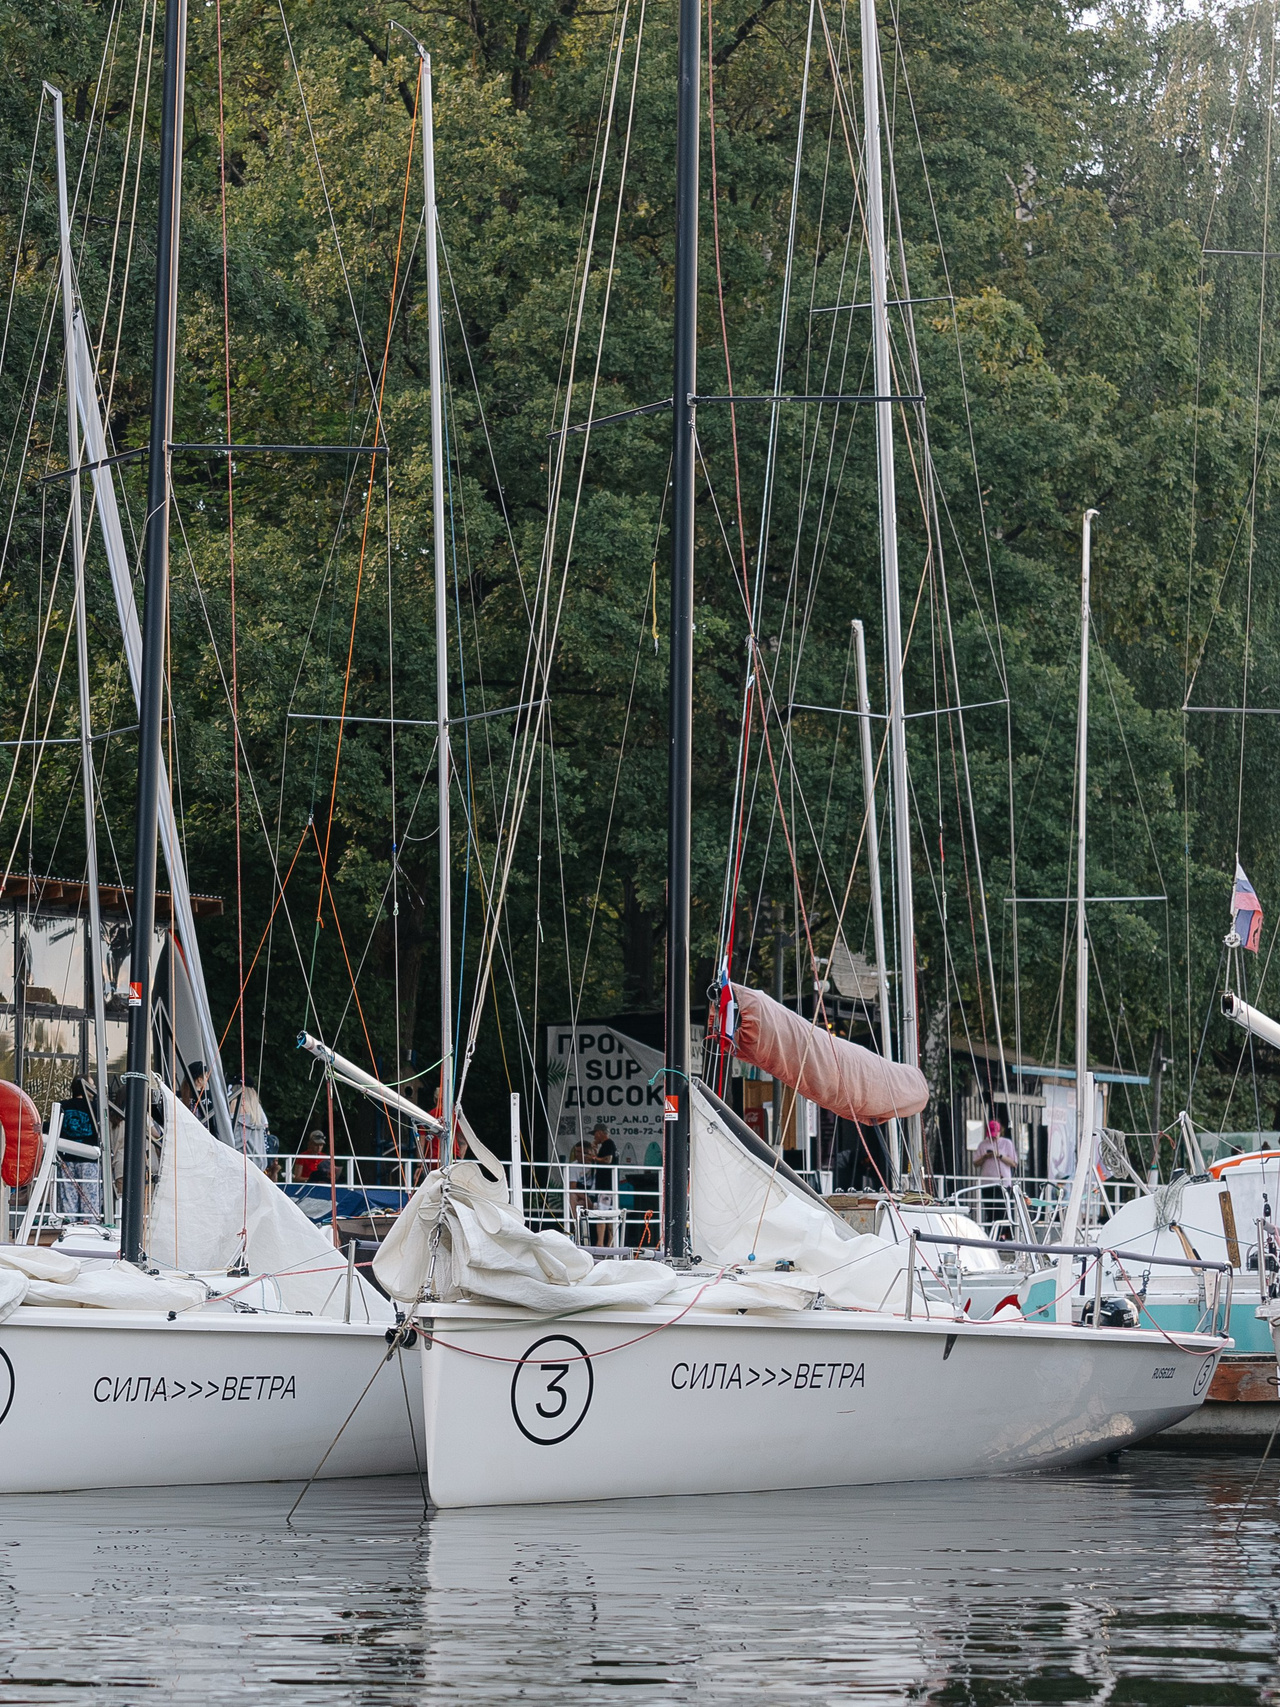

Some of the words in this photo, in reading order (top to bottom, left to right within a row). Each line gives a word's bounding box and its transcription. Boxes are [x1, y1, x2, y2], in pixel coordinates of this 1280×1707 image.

[585, 1059, 642, 1081] SUP
[565, 1084, 664, 1109] ДОСОК
[623, 1127, 664, 1135] 708-72-4
[1198, 1364, 1211, 1386] 3
[535, 1364, 569, 1418] 3
